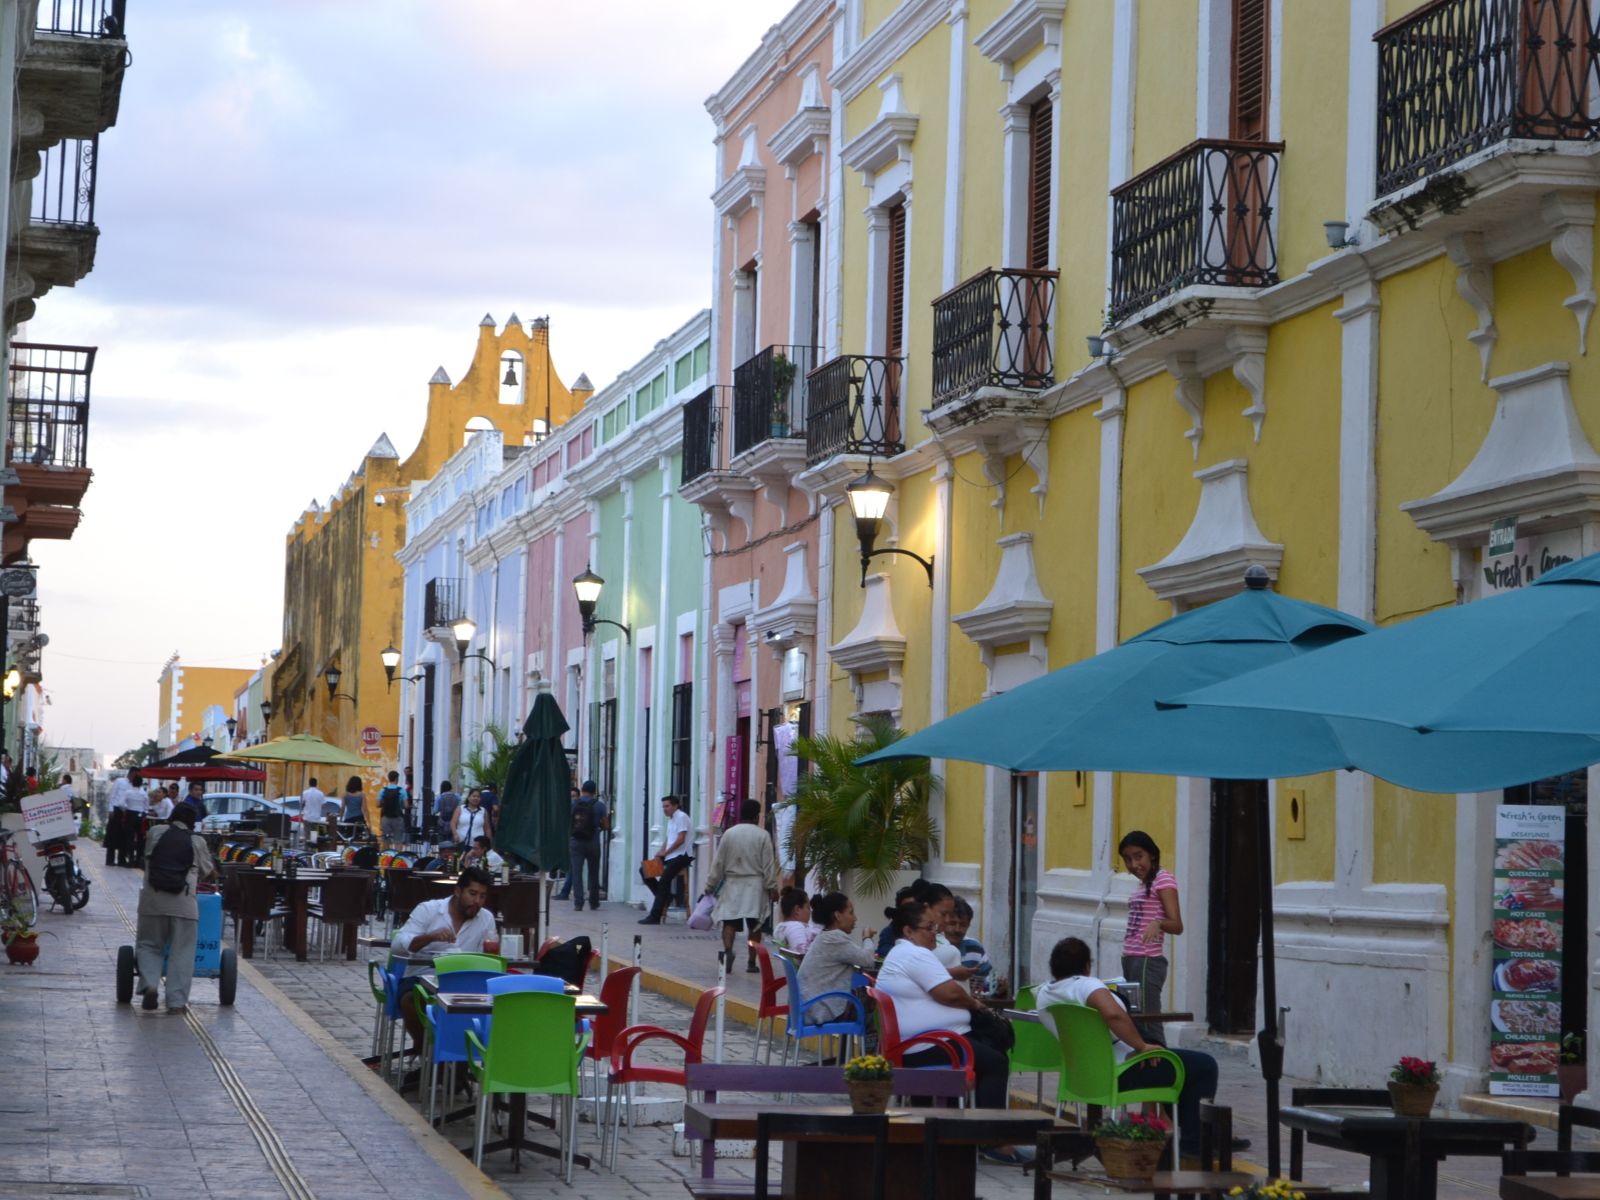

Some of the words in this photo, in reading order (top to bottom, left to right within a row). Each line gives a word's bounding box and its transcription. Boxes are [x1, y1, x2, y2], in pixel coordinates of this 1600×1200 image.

[1489, 526, 1515, 547] ENTRADA
[362, 731, 380, 741] ALTO
[1507, 1074, 1541, 1082] MOLLETES
